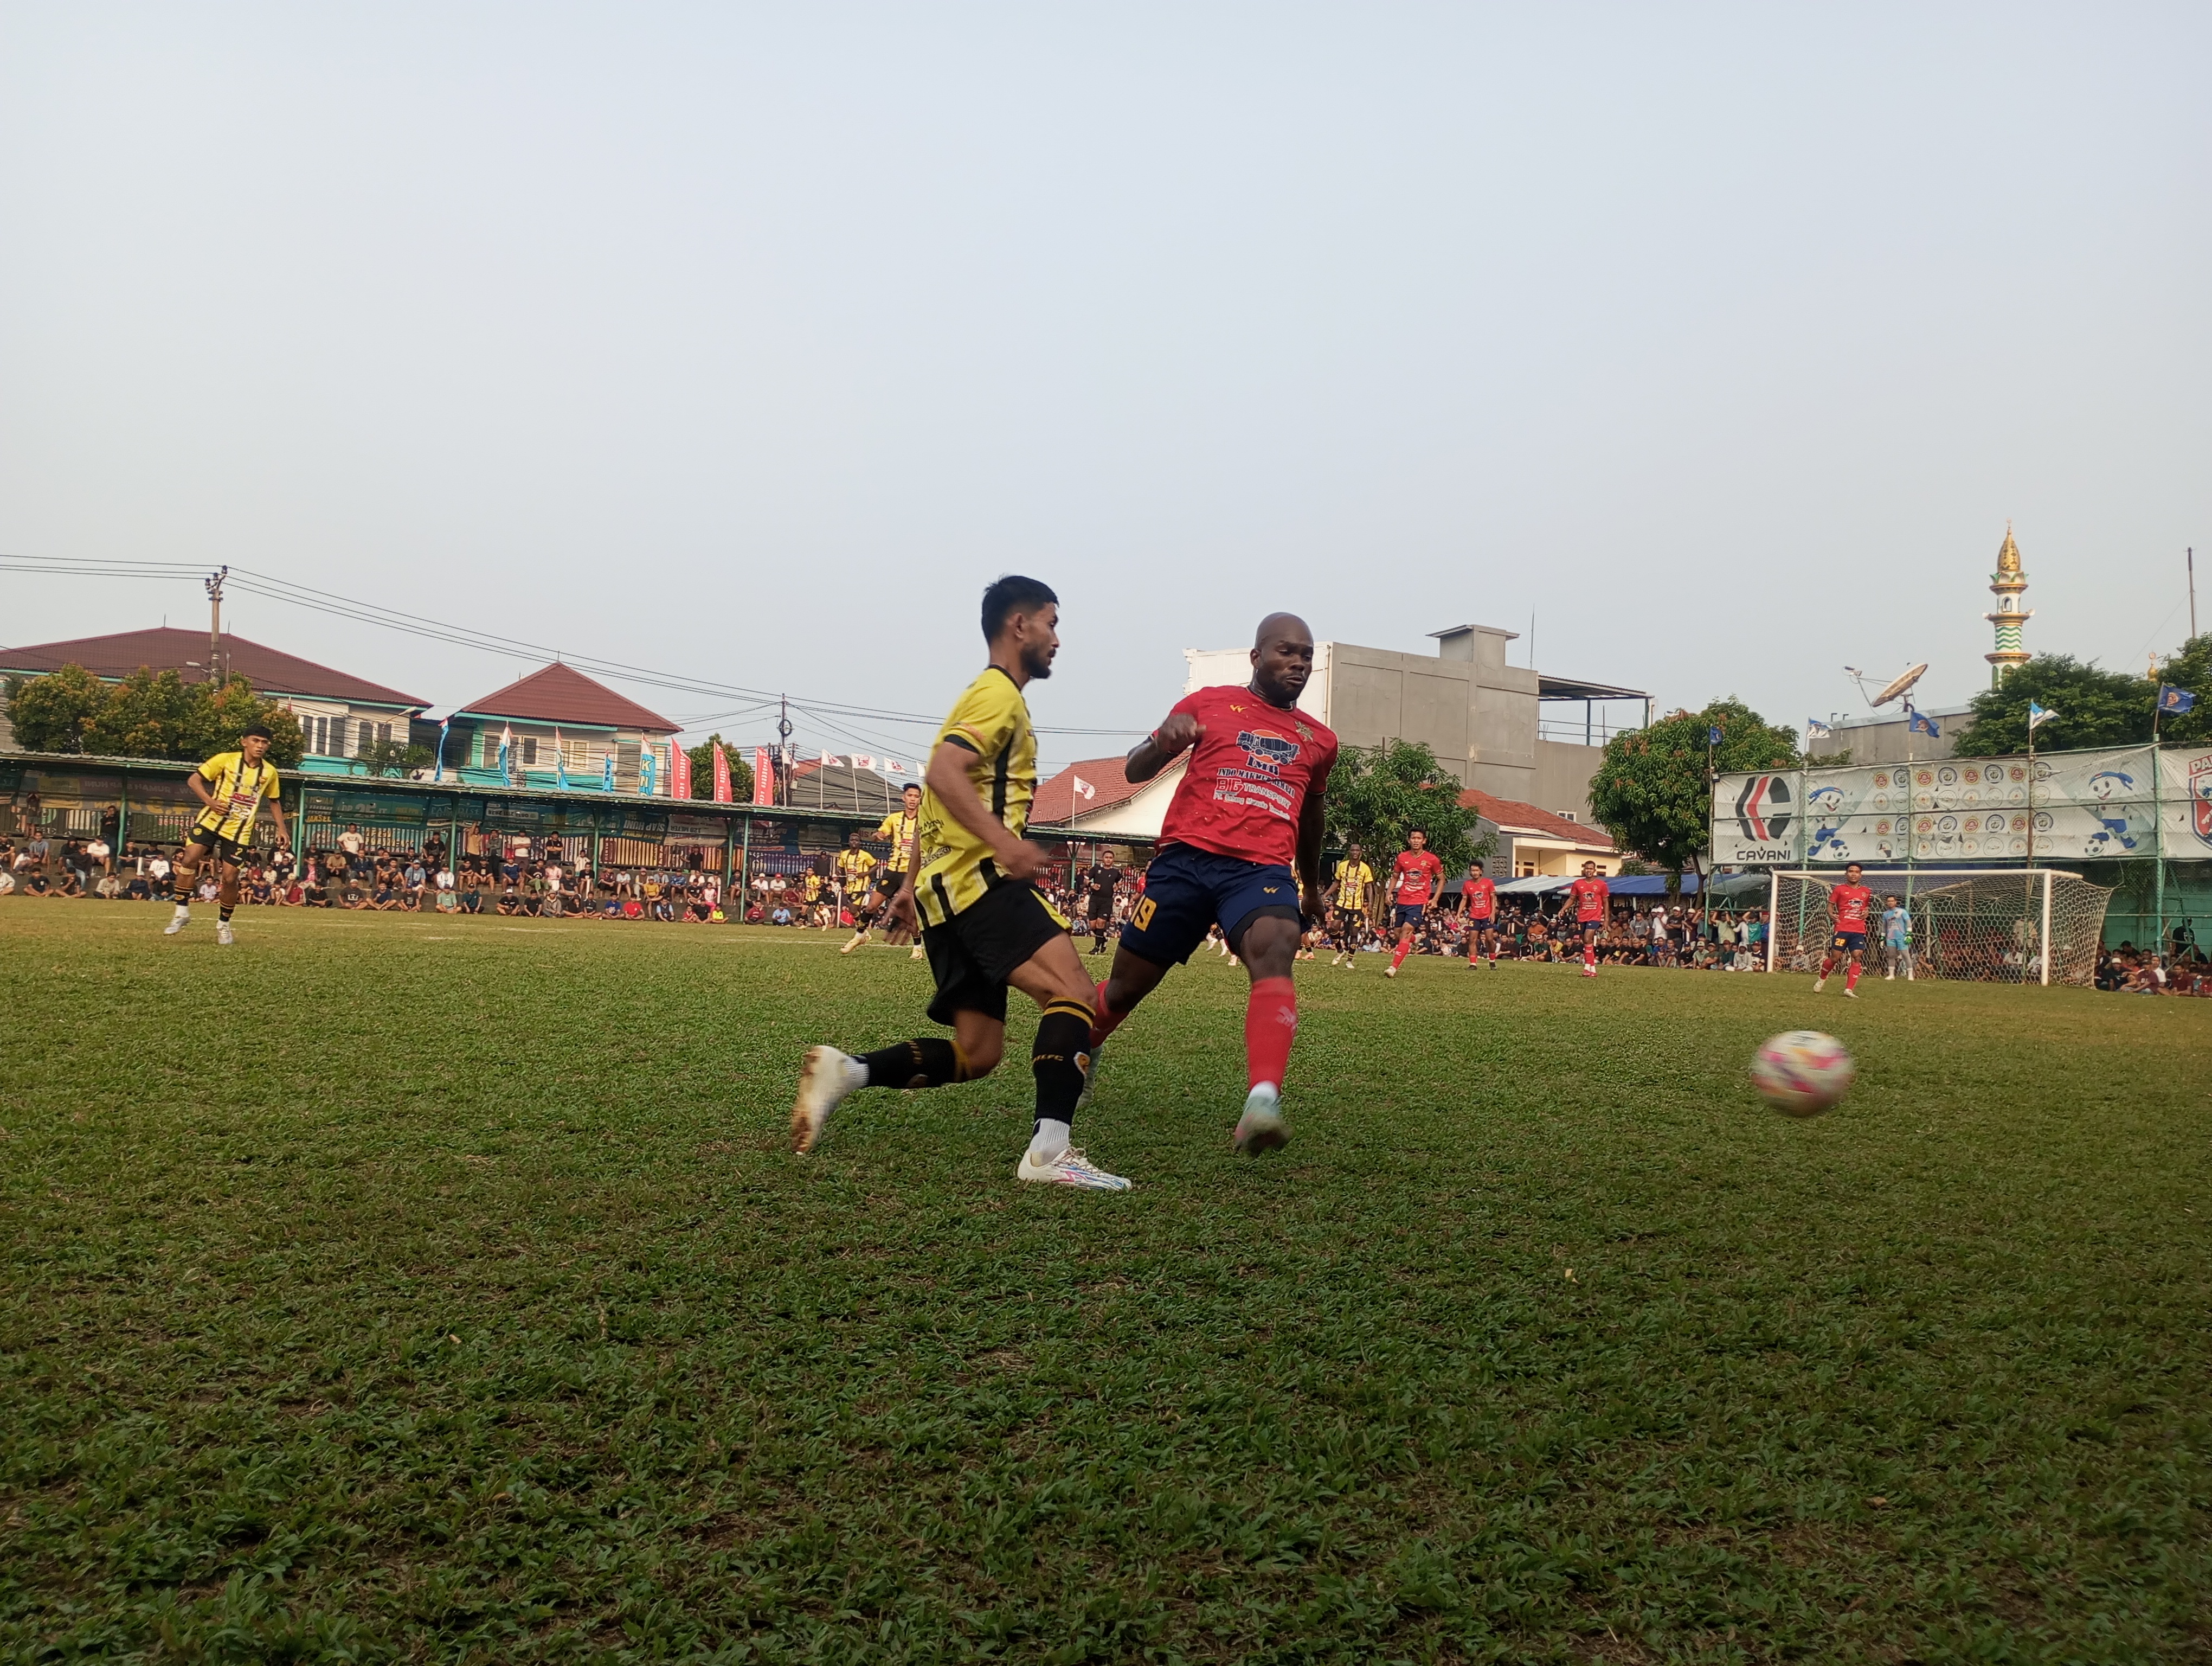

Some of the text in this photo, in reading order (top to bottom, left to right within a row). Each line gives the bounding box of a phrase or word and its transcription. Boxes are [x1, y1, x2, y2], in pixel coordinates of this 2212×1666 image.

[2191, 755, 2212, 773] PA
[1217, 767, 1237, 777] INDO
[1214, 777, 1291, 809] BIG TRANSPORT
[623, 819, 645, 831] HUNI
[1737, 850, 1791, 861] CAVANI
